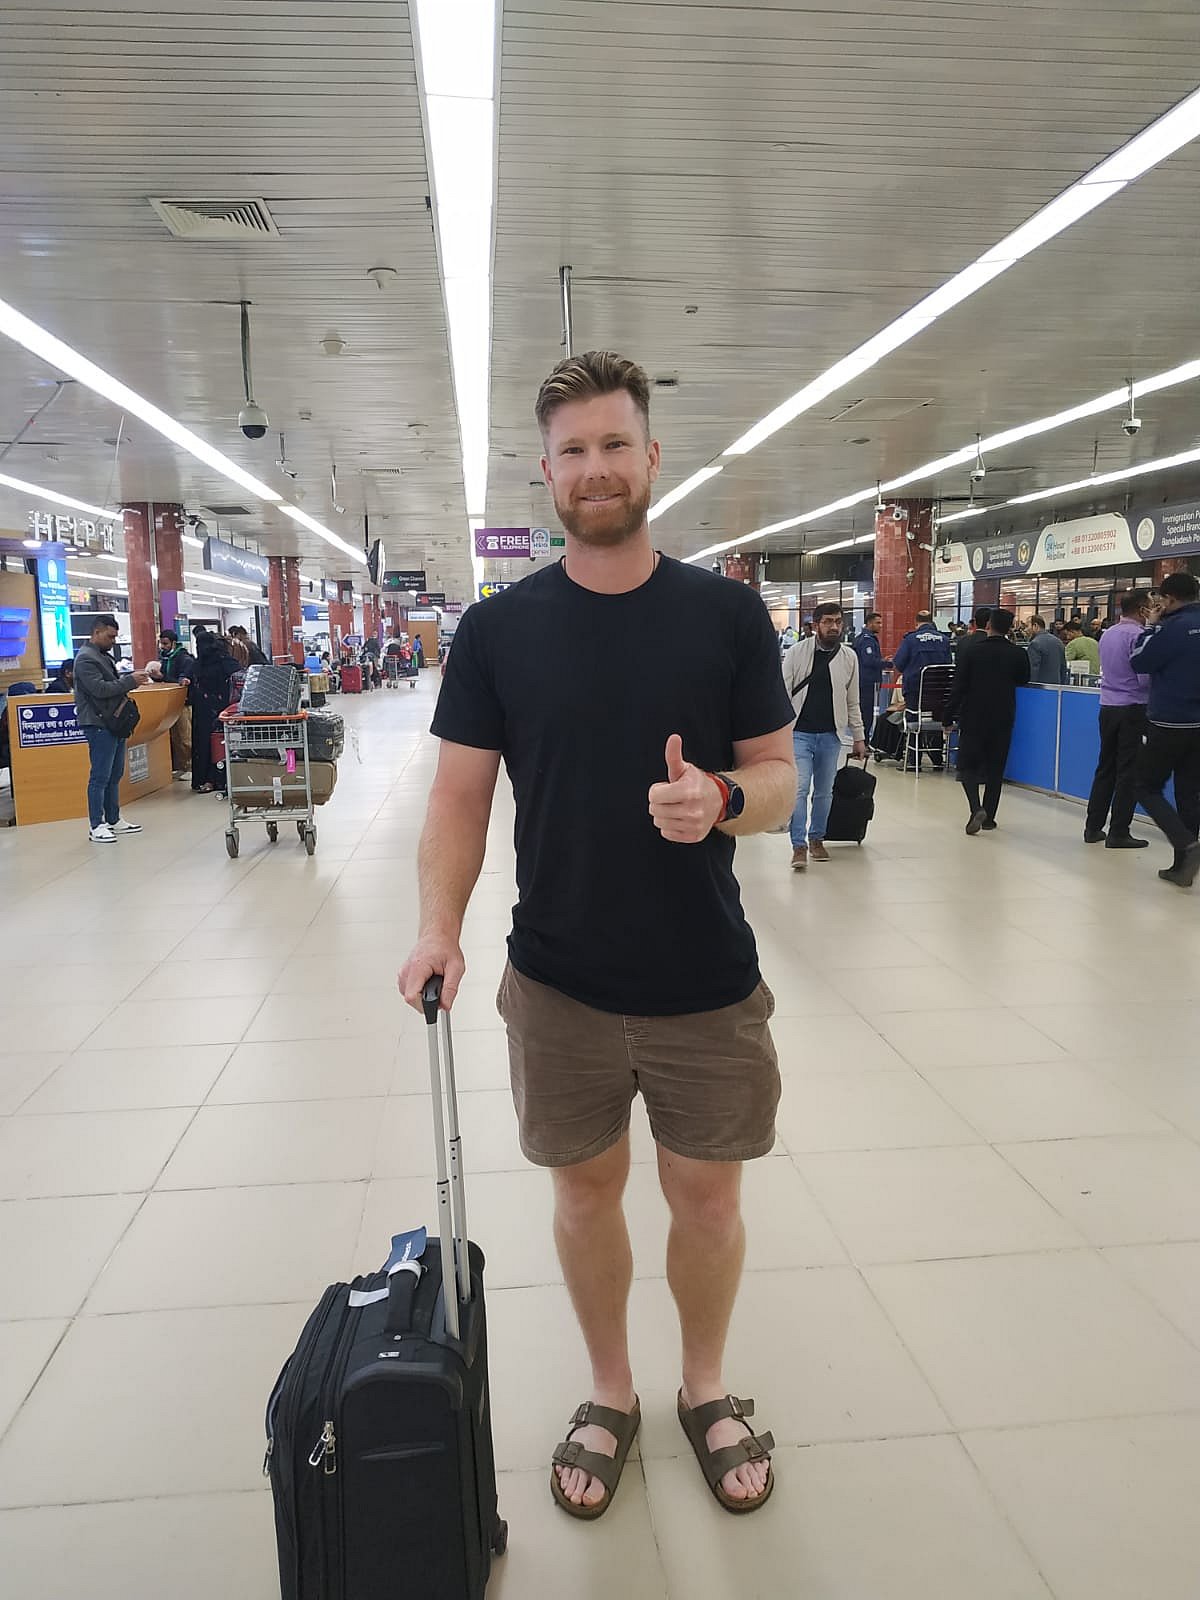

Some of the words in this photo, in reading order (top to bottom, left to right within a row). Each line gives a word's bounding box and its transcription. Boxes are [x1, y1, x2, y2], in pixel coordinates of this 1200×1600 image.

[1162, 511, 1195, 524] Immigration
[34, 511, 96, 547] HELP
[1166, 523, 1186, 535] Special
[500, 535, 529, 545] FREE
[1161, 534, 1192, 547] Bangladesh
[34, 731, 63, 739] Information
